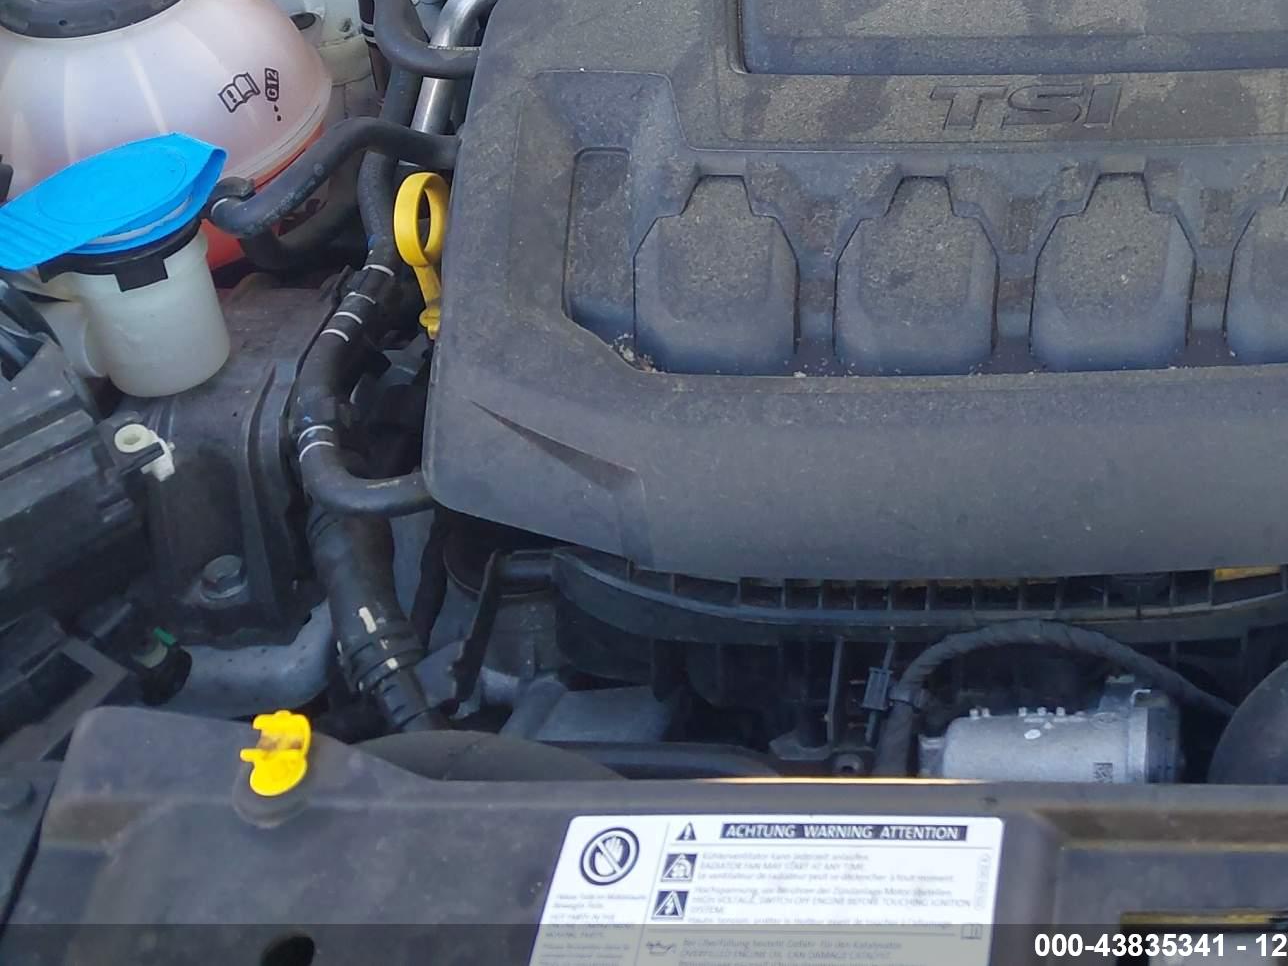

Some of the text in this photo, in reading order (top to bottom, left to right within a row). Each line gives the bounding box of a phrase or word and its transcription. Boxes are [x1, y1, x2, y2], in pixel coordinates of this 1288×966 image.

[929, 84, 1123, 130] TSI
[725, 824, 959, 841] ACHTUNG WARNING ATTENTION
